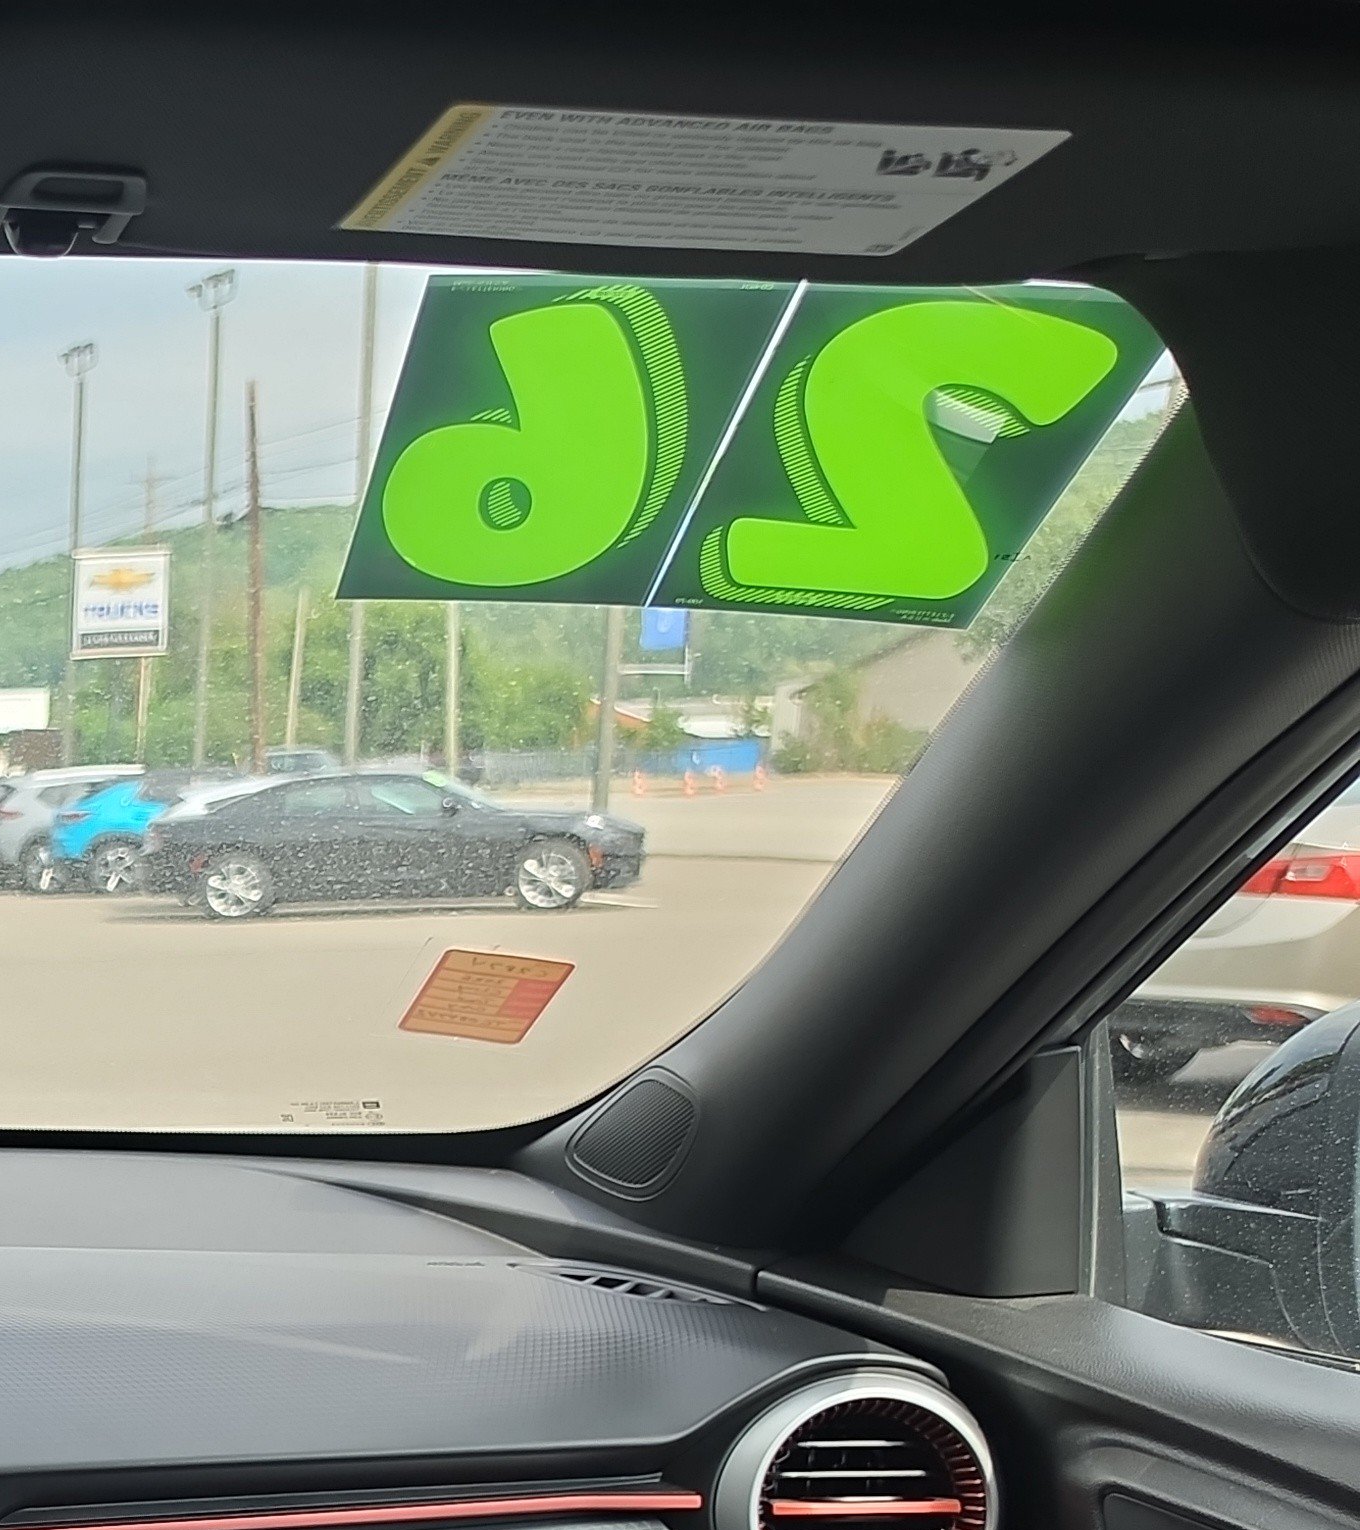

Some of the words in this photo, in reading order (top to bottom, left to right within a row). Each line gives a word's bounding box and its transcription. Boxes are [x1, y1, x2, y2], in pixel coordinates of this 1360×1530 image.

[500, 110, 555, 121] EVEN
[559, 113, 613, 125] WITH
[615, 116, 731, 129] ADVANCED
[733, 122, 771, 132] AIR
[500, 176, 548, 187] AVEC
[552, 179, 589, 189] DES
[593, 182, 643, 192] SACS
